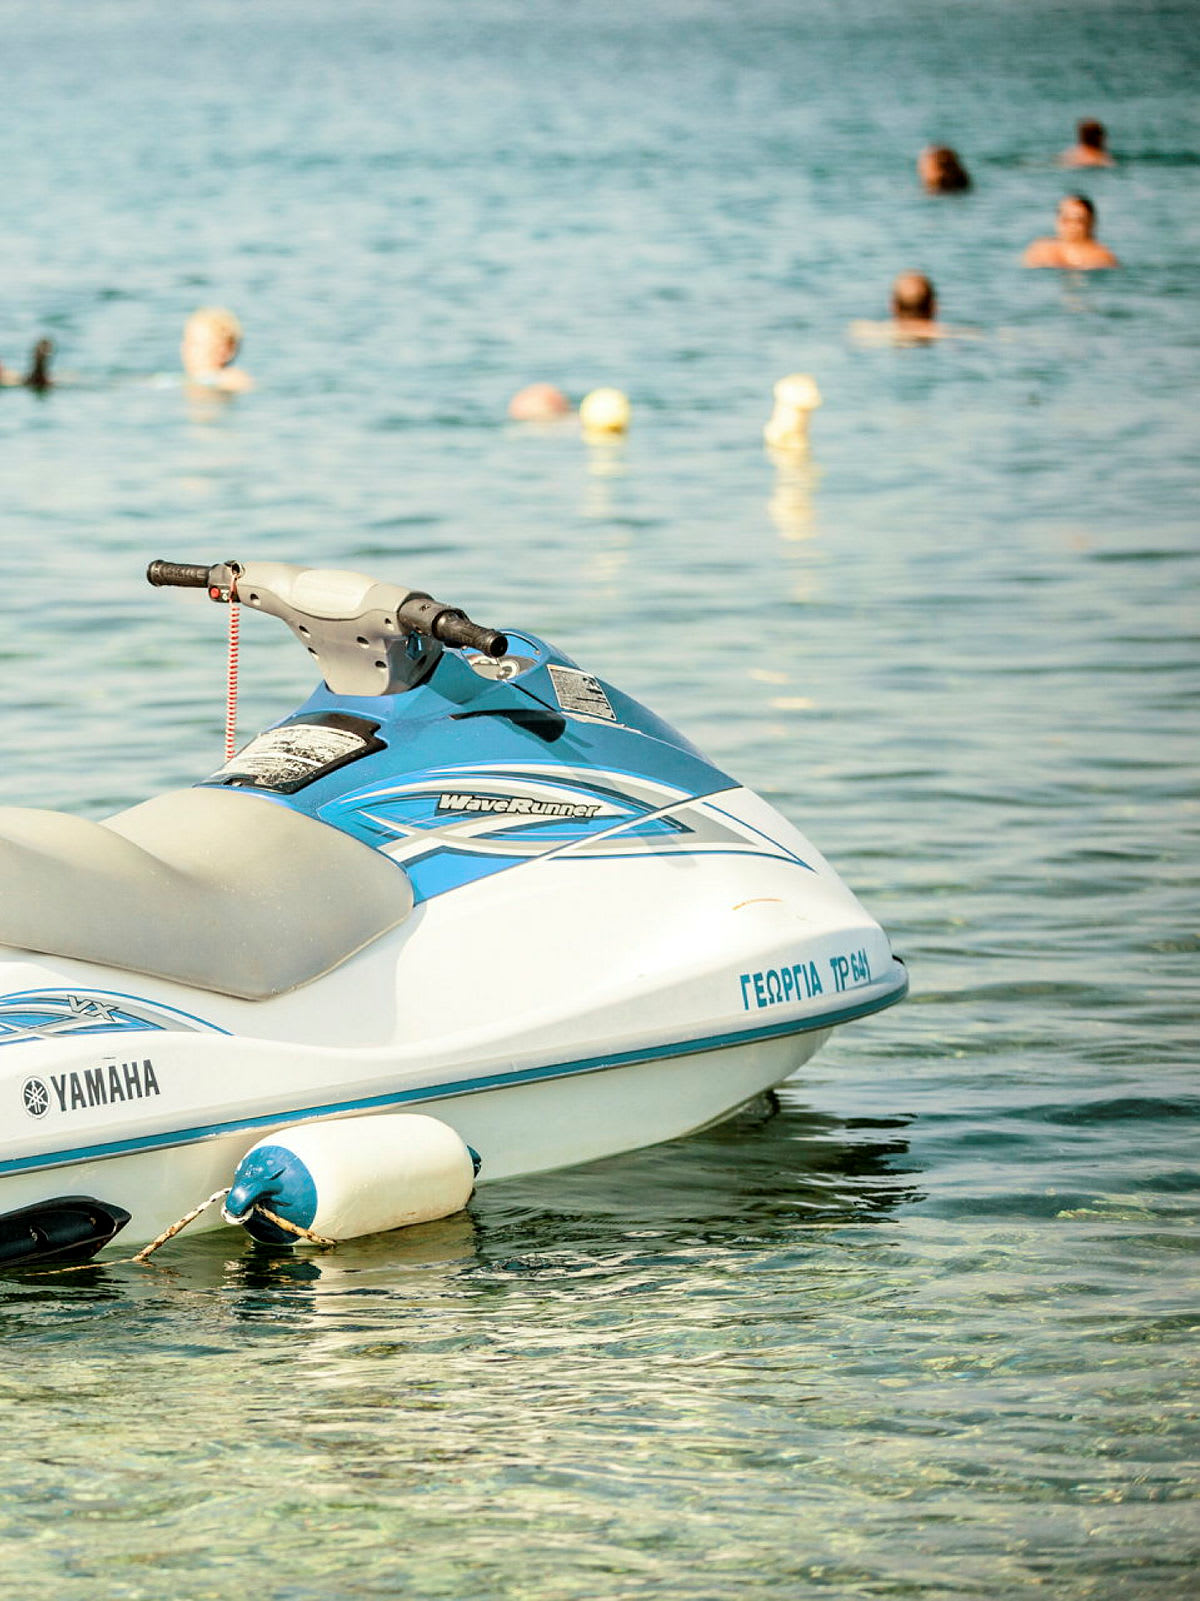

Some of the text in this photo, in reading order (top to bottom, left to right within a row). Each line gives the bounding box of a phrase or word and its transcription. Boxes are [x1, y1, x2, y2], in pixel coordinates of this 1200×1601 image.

[437, 793, 603, 818] WaveRunner
[739, 960, 823, 1011] ΓΕΩΡΓΙΑ
[66, 994, 120, 1022] VX
[50, 1059, 161, 1112] YAMAHA
